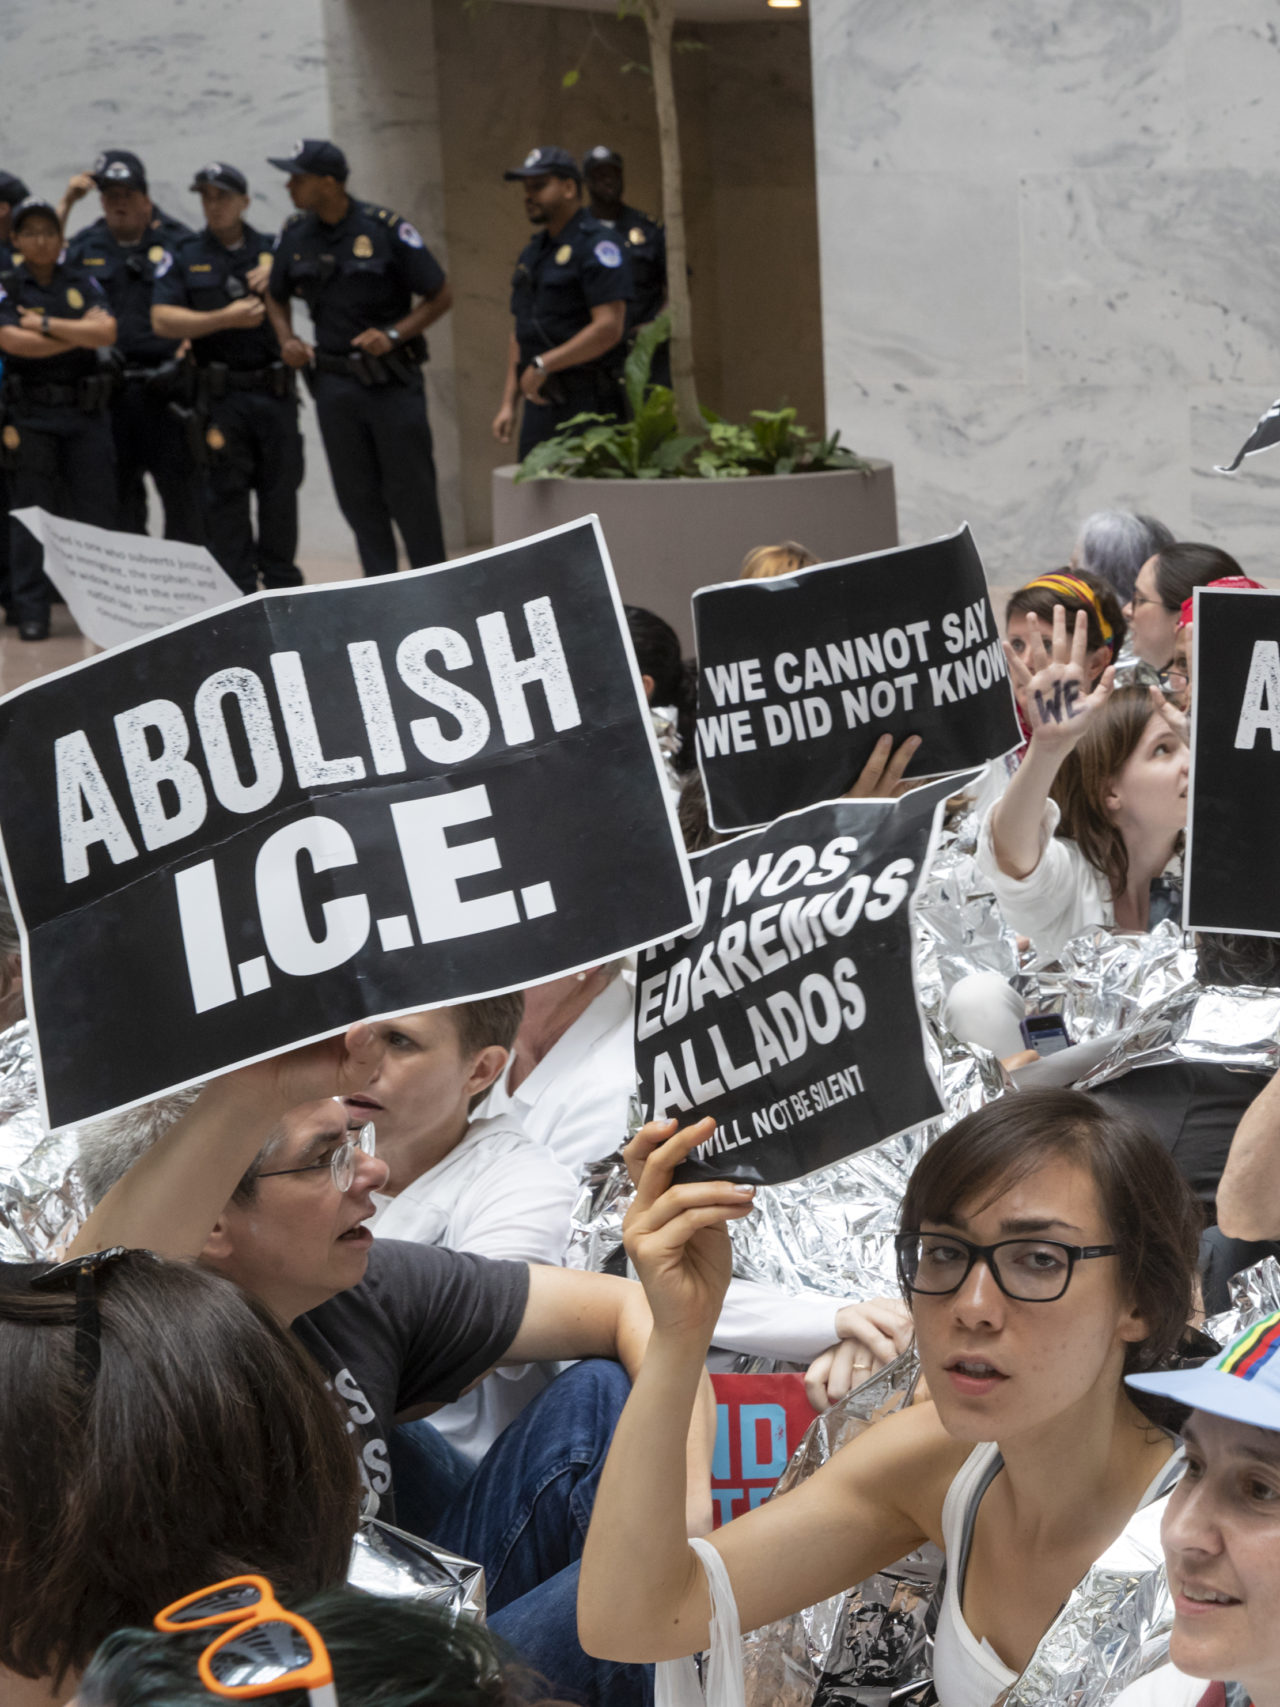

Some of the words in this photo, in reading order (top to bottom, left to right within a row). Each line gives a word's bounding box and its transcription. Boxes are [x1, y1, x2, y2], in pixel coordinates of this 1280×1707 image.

[696, 712, 757, 758] WE
[764, 690, 833, 747] DID
[841, 674, 919, 730] NOT
[929, 638, 1007, 707] KNOW
[704, 658, 767, 707] WE
[773, 620, 931, 695] CANNOT
[941, 597, 990, 654] SAY
[1034, 679, 1092, 725] WE
[54, 595, 582, 884] ABOLISH
[174, 784, 557, 1014] I.C.E.
[722, 836, 859, 917] NOS
[637, 957, 867, 1121] ALLADOS
[751, 1098, 794, 1138] NOT
[789, 1089, 814, 1122] BE
[809, 1064, 866, 1112] SILENT
